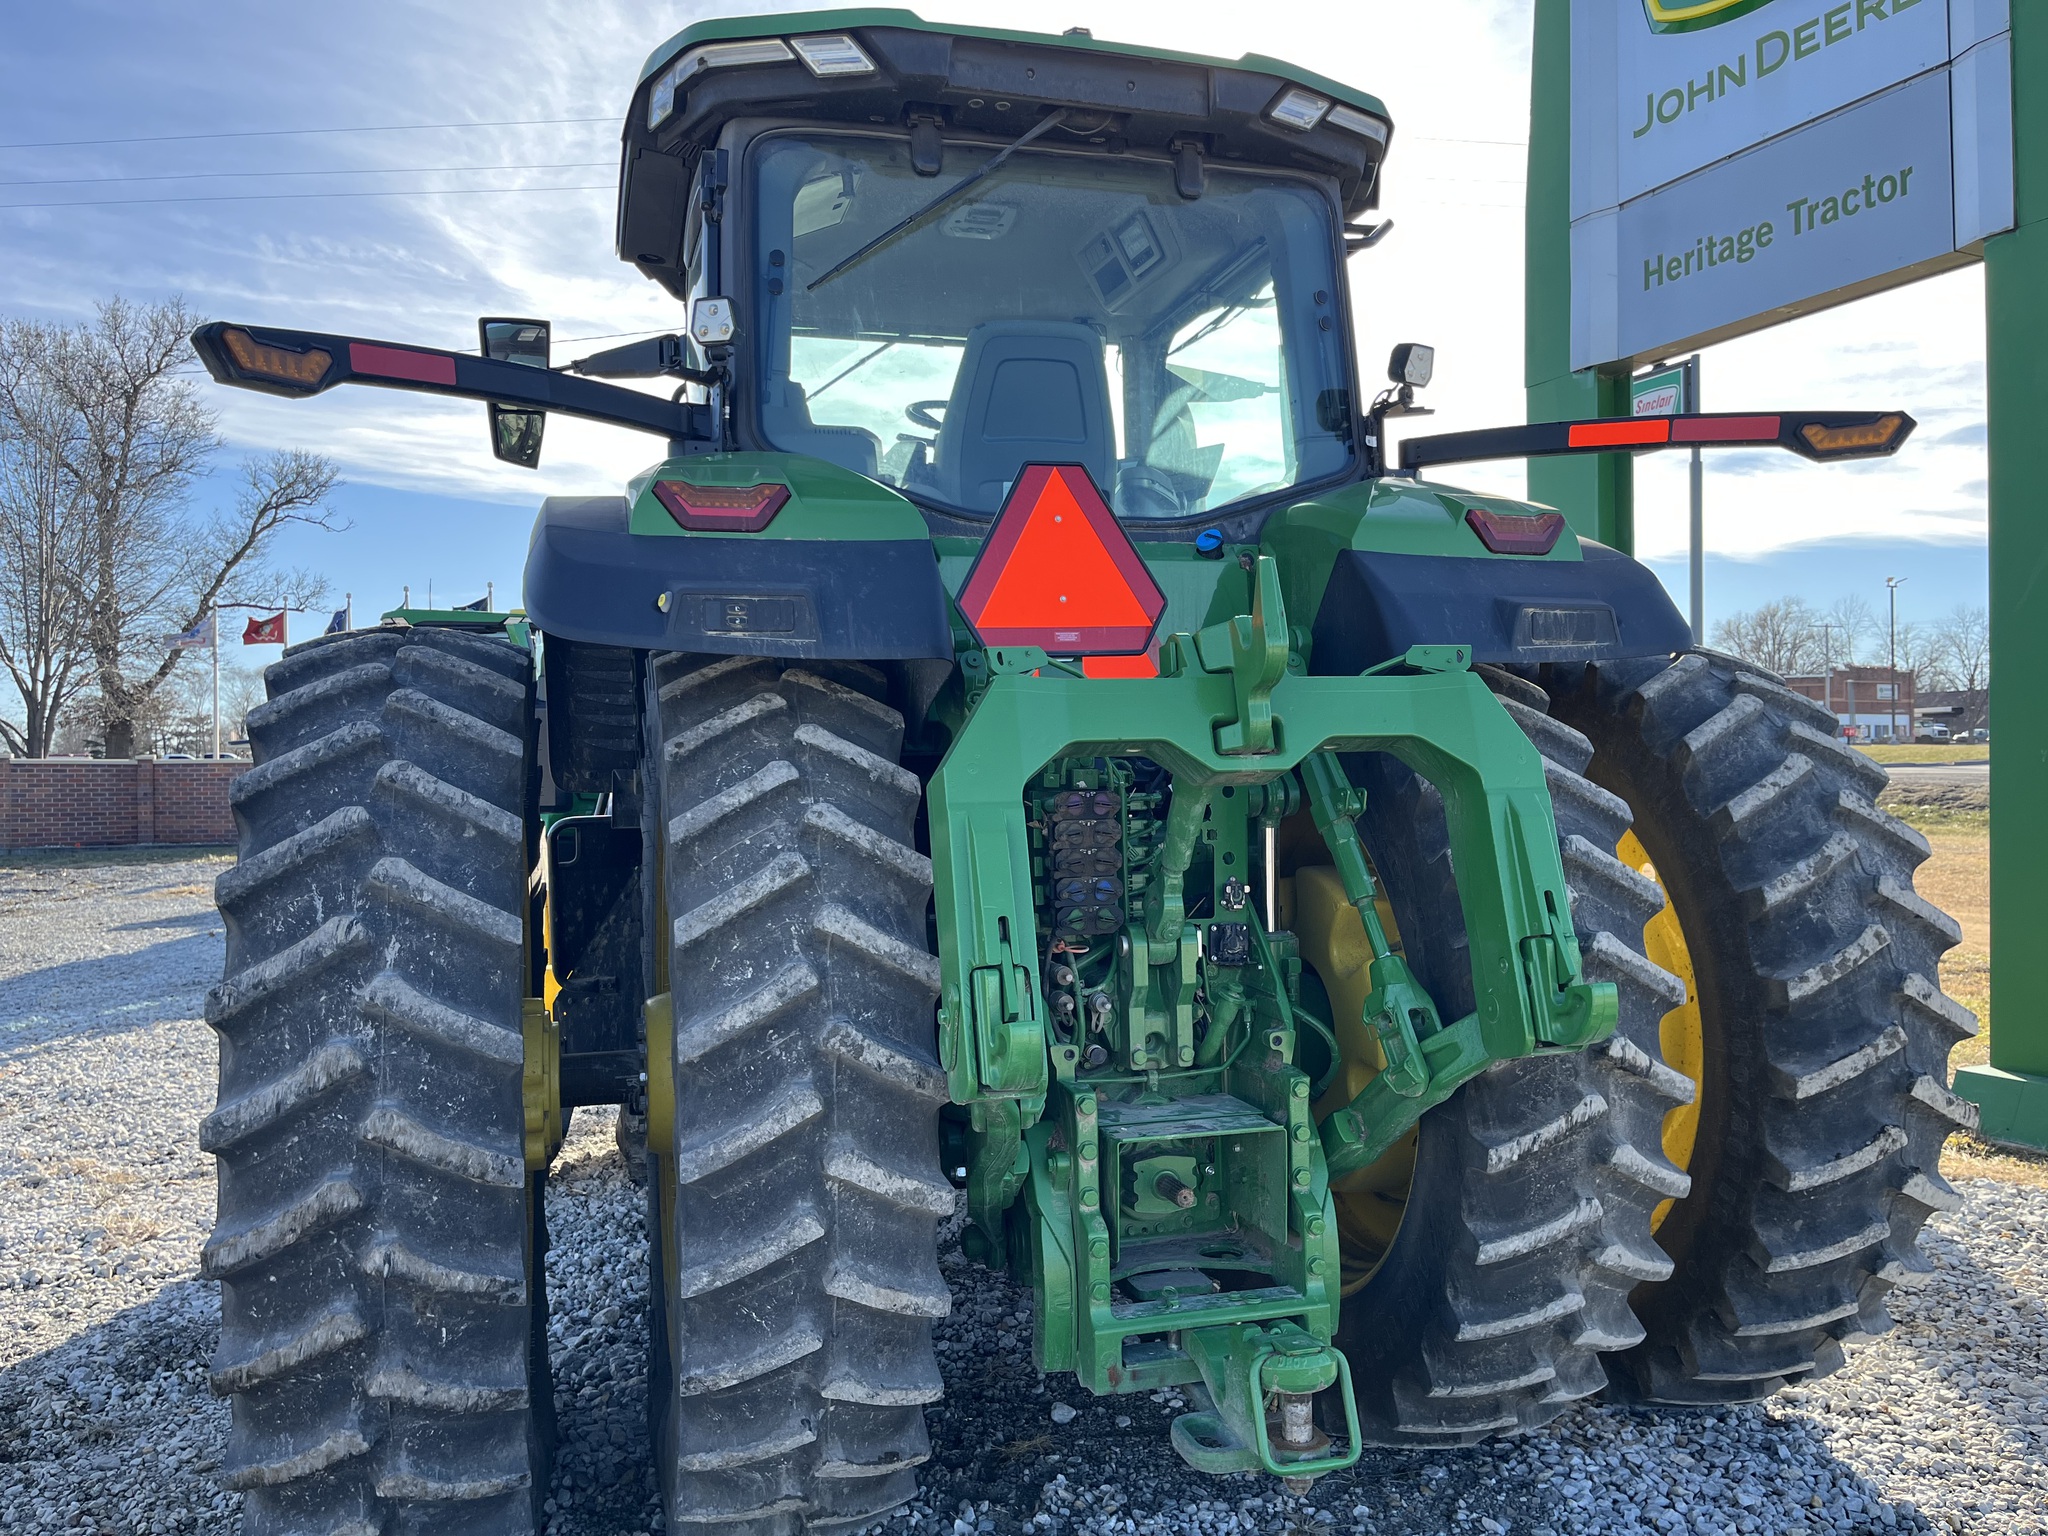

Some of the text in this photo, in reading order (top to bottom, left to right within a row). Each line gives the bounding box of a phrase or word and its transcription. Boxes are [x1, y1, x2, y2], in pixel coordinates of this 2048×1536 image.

[1632, 52, 1747, 139] JOHN
[1643, 165, 1913, 292] Heritage Tractor
[1635, 394, 1674, 415] Sinclair
